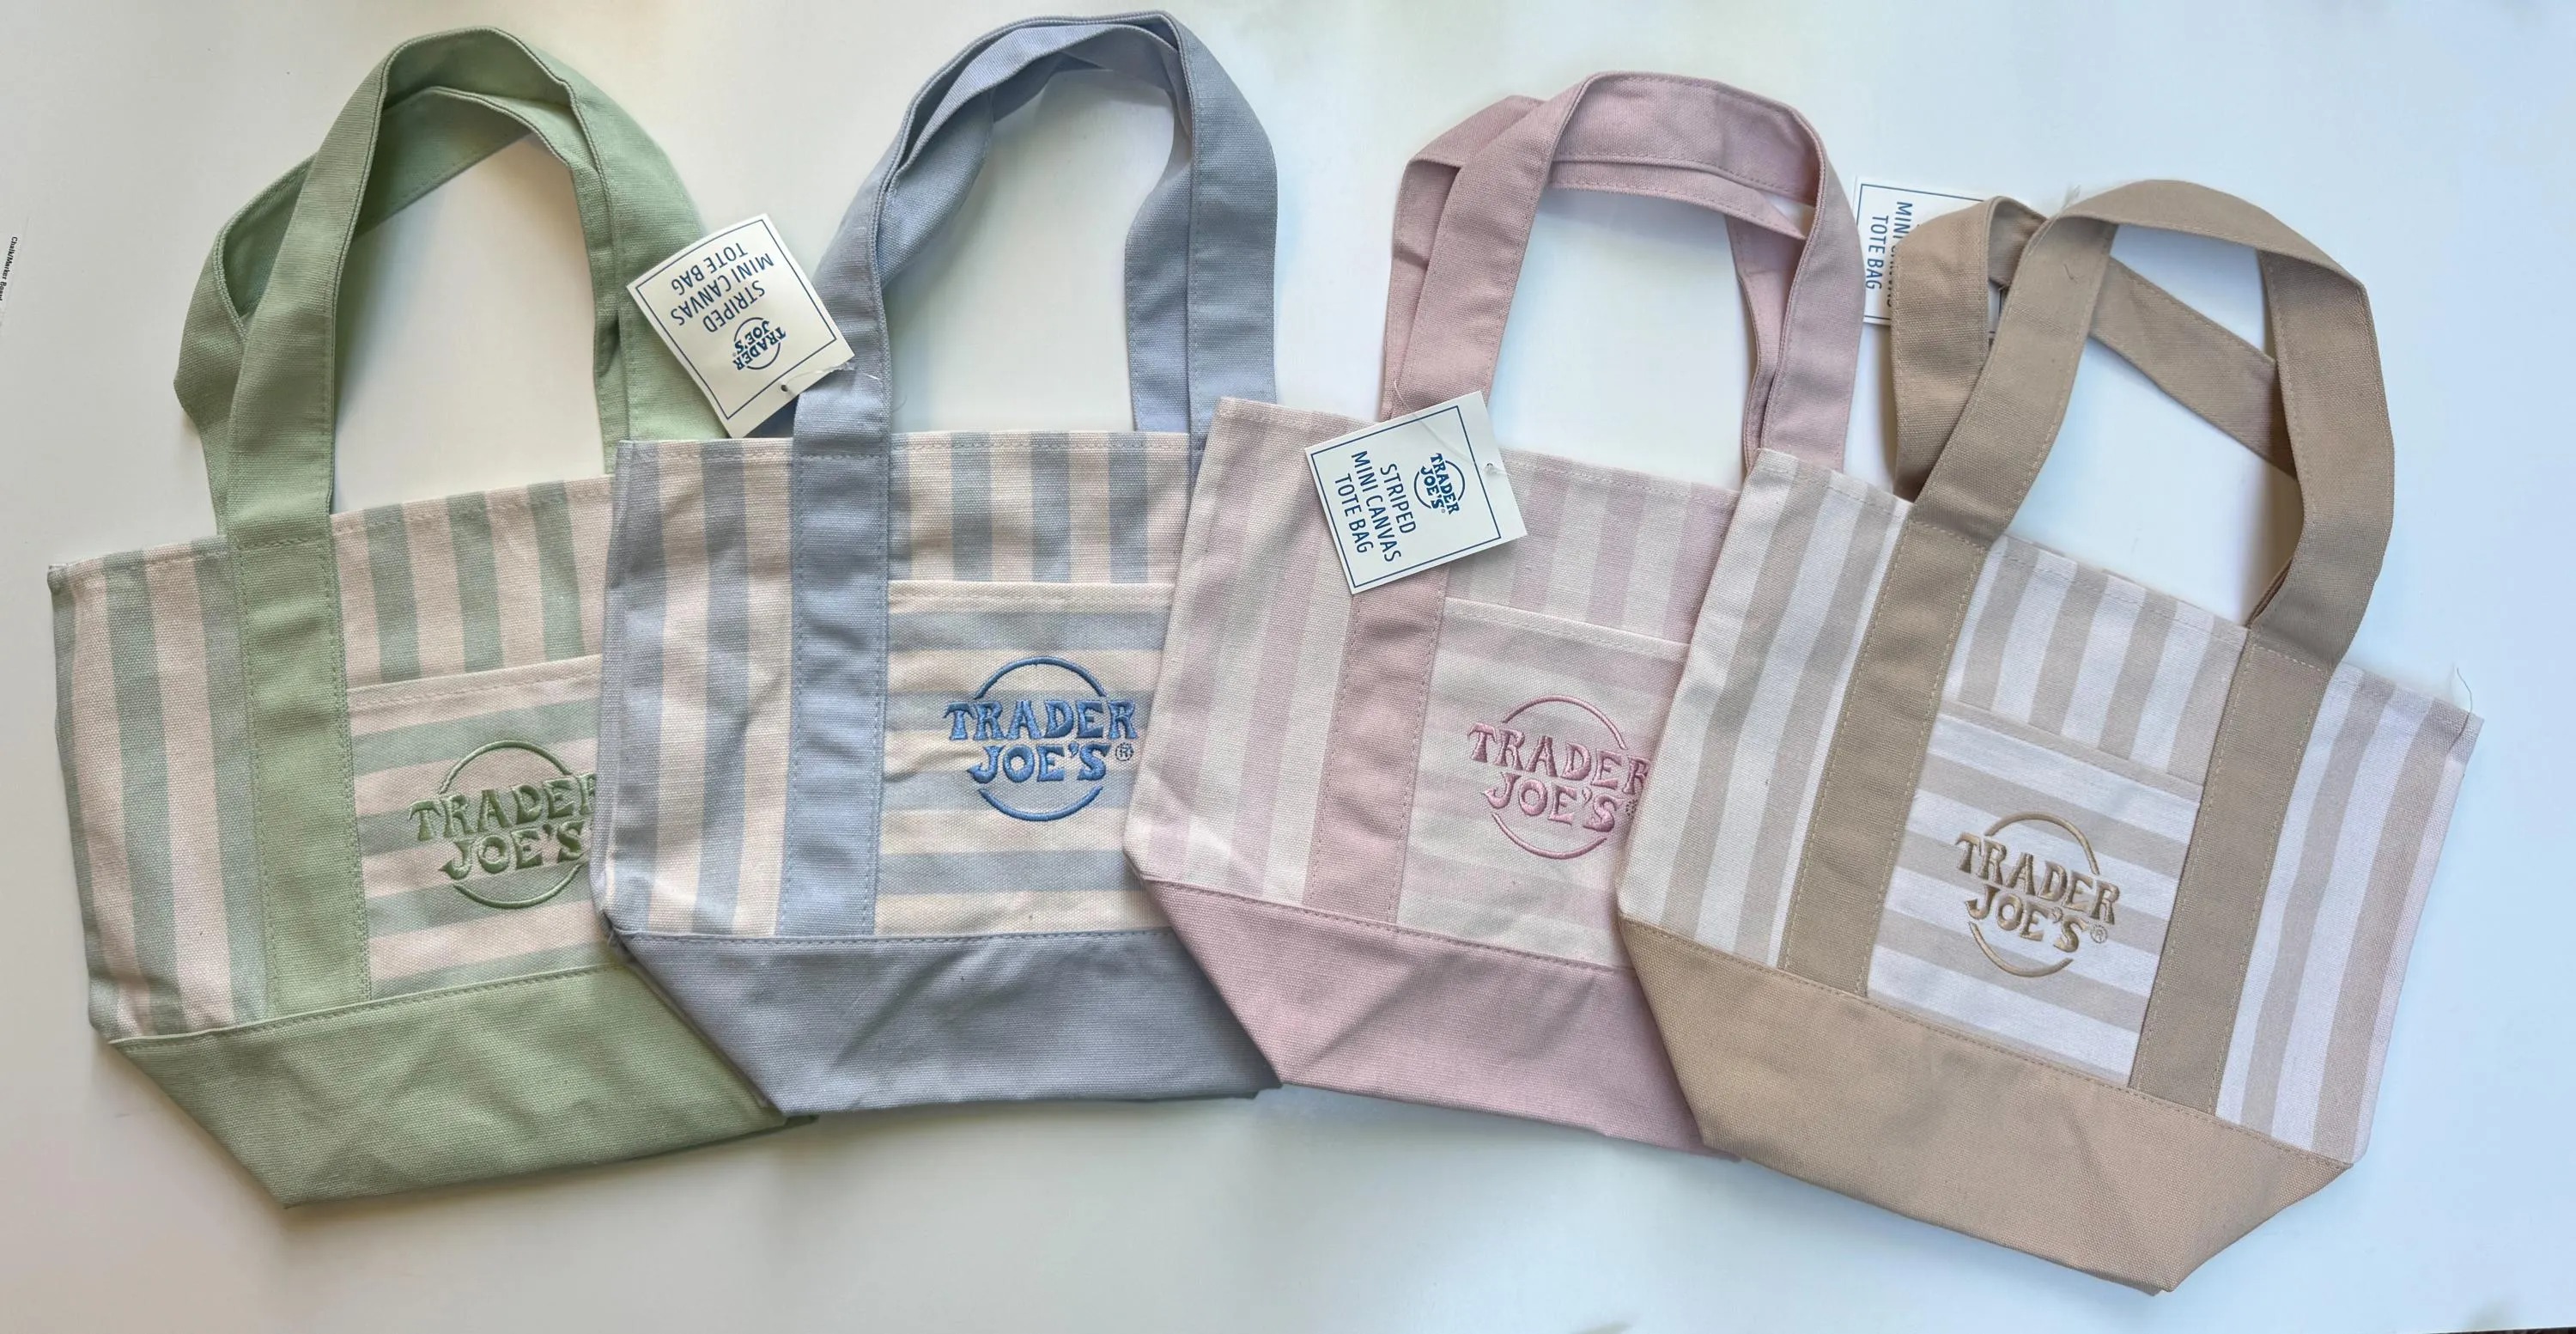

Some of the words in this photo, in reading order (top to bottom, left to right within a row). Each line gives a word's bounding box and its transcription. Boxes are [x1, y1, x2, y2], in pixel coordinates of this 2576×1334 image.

[703, 242, 748, 273] TOTE
[1868, 215, 1889, 254] TOTE
[671, 265, 704, 295] BAG
[732, 253, 775, 283] MINI
[1865, 259, 1885, 289] BAG
[671, 274, 732, 326] CANVAS
[702, 280, 765, 332] STRIPED
[732, 326, 787, 371] TRADER
[734, 320, 770, 354] JOE'S
[1351, 450, 1378, 493] MINI
[1365, 495, 1401, 562] CANVAS
[1380, 463, 1417, 533] STRIPED
[1420, 466, 1445, 510] JOE'S
[1430, 453, 1460, 515] TRADER
[1334, 473, 1362, 517] TOTE
[1348, 518, 1374, 553] BAG
[943, 700, 1138, 740] TRADER
[967, 742, 1112, 784] JOE'S
[1467, 722, 1651, 795] TRADER
[1481, 772, 1625, 832] JOE'S
[438, 819, 586, 880] JOE'S
[1954, 831, 2120, 925] TRADER
[1964, 883, 2090, 953] JOE'S
